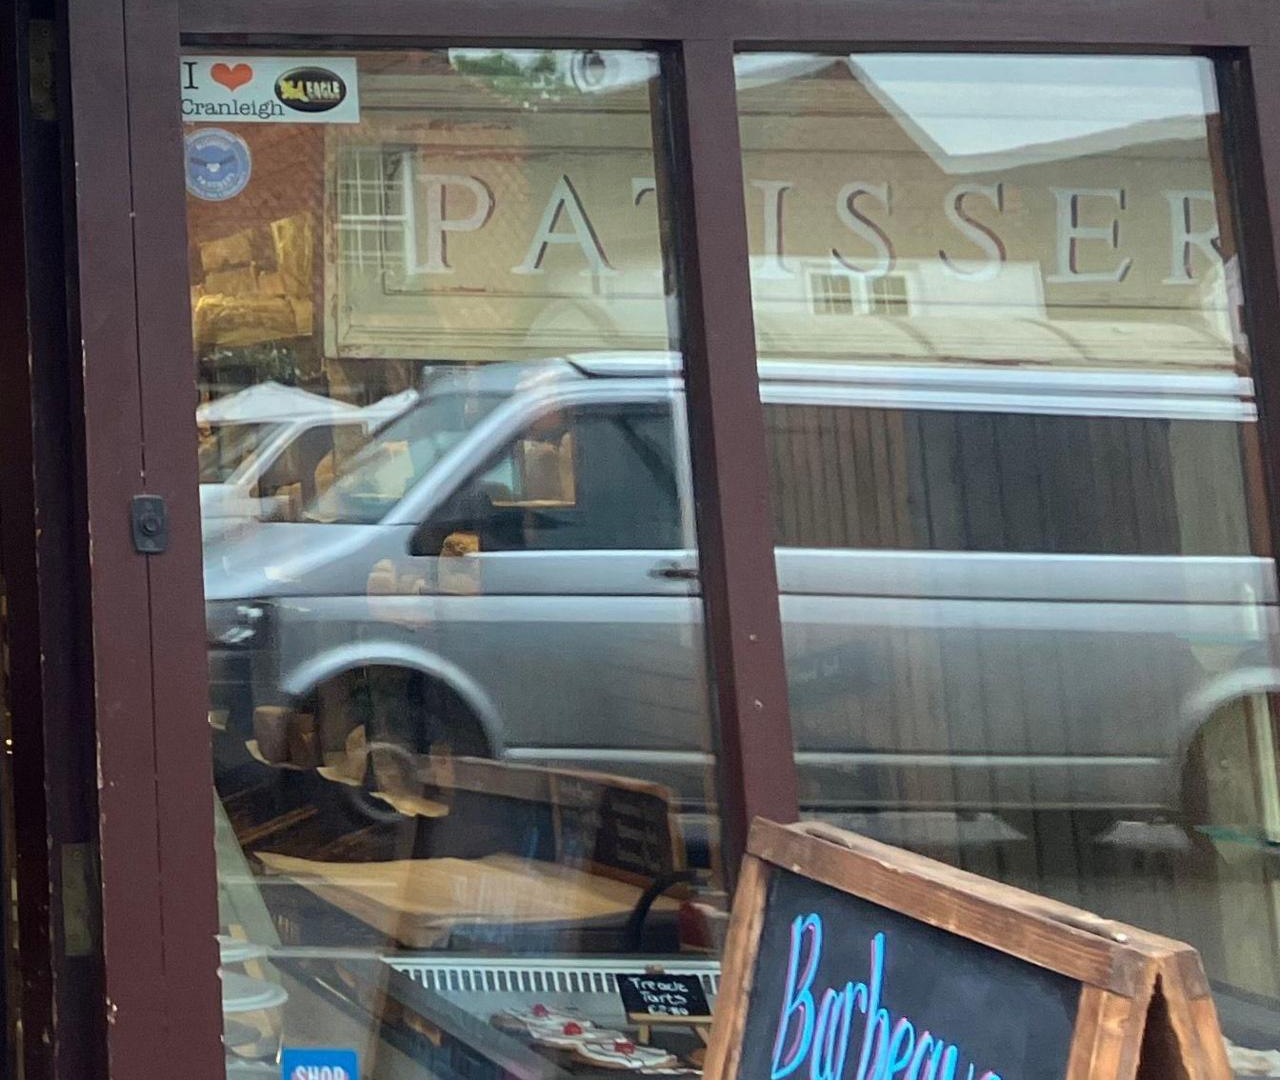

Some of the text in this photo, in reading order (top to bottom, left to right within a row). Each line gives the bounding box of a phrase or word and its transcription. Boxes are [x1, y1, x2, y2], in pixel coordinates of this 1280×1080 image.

[182, 61, 199, 90] I
[180, 98, 286, 120] Cranleigh
[639, 990, 688, 1005] Tarts
